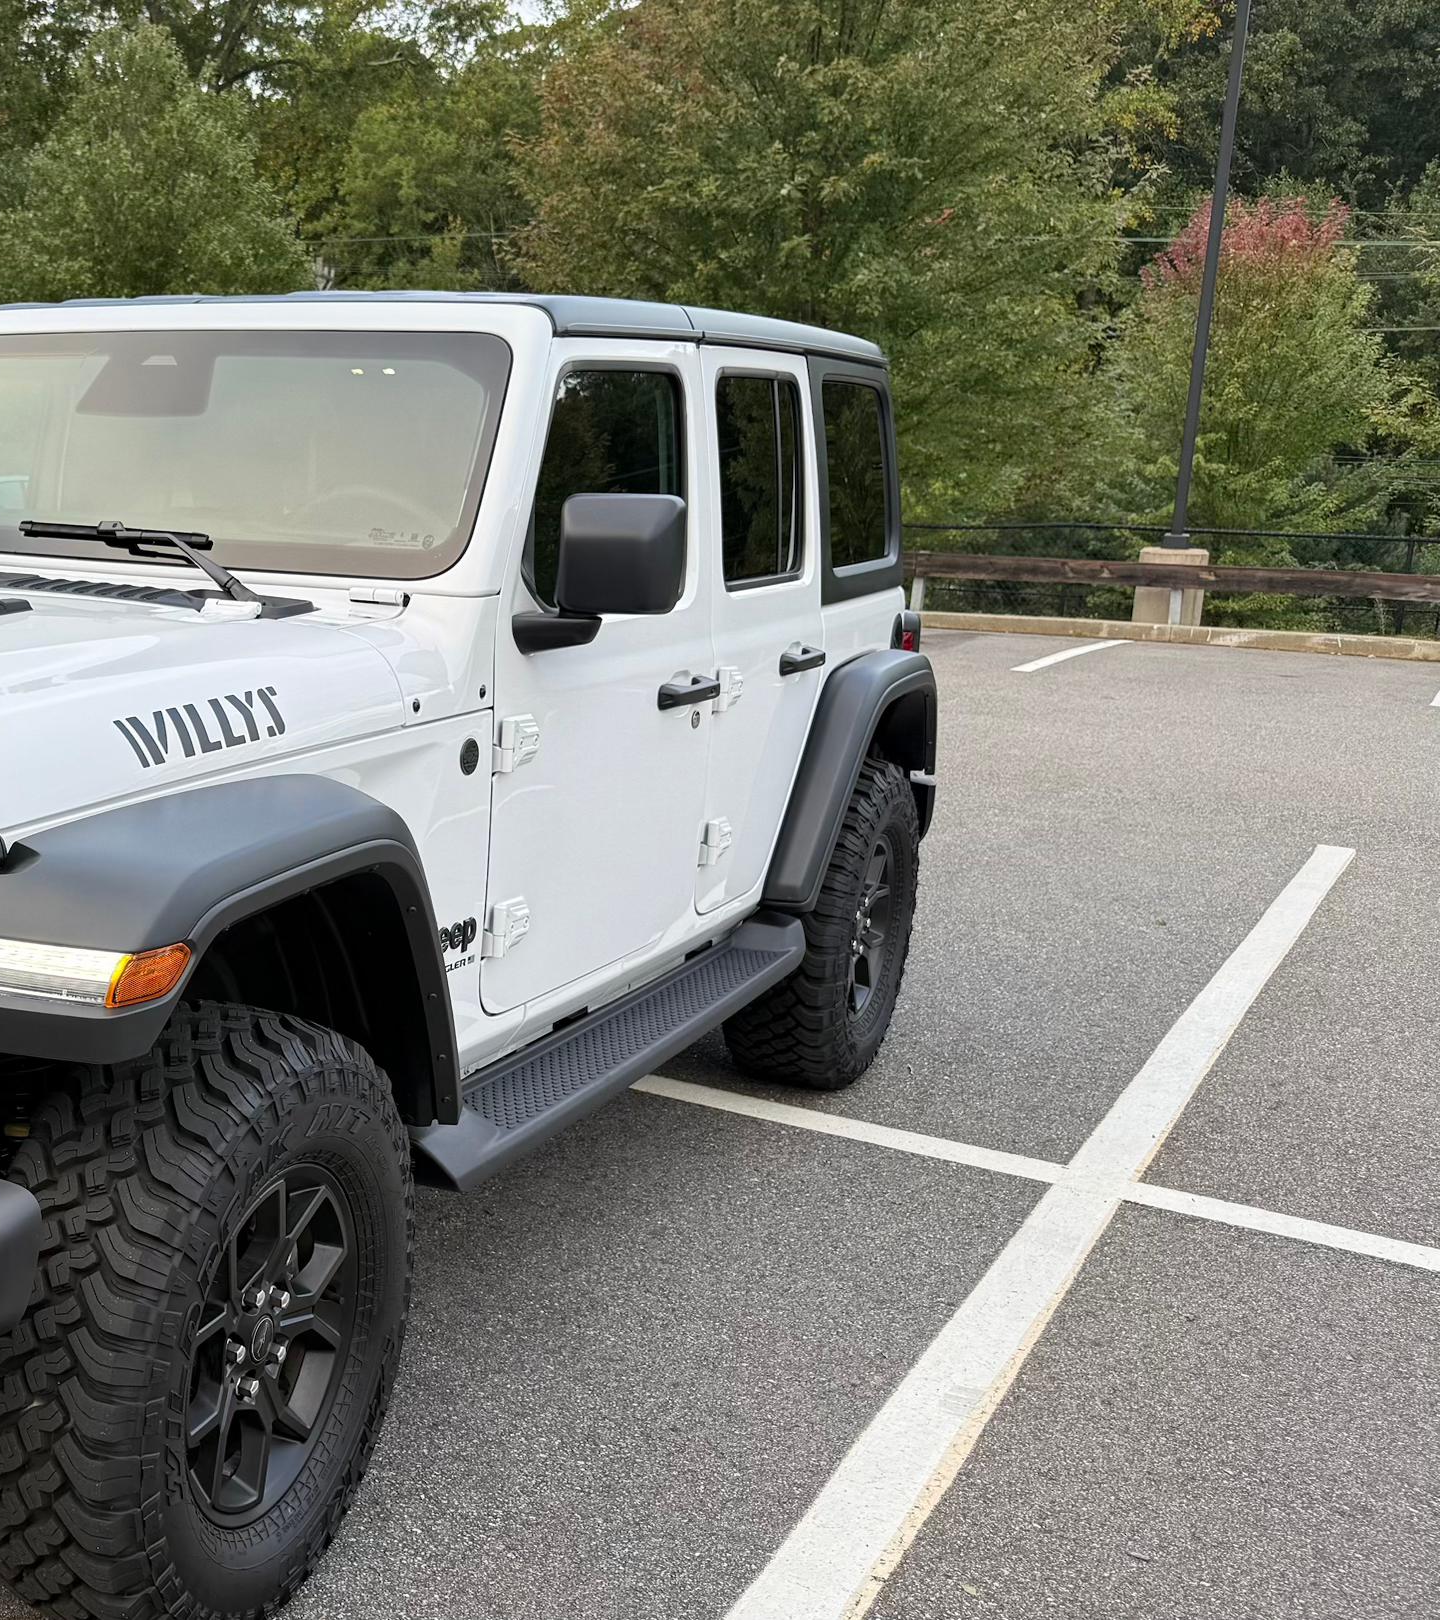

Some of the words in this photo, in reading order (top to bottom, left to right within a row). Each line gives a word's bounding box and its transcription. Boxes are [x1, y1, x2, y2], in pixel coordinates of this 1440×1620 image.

[112, 685, 287, 769] WILLYS
[439, 916, 477, 953] eep
[445, 958, 466, 972] GLER
